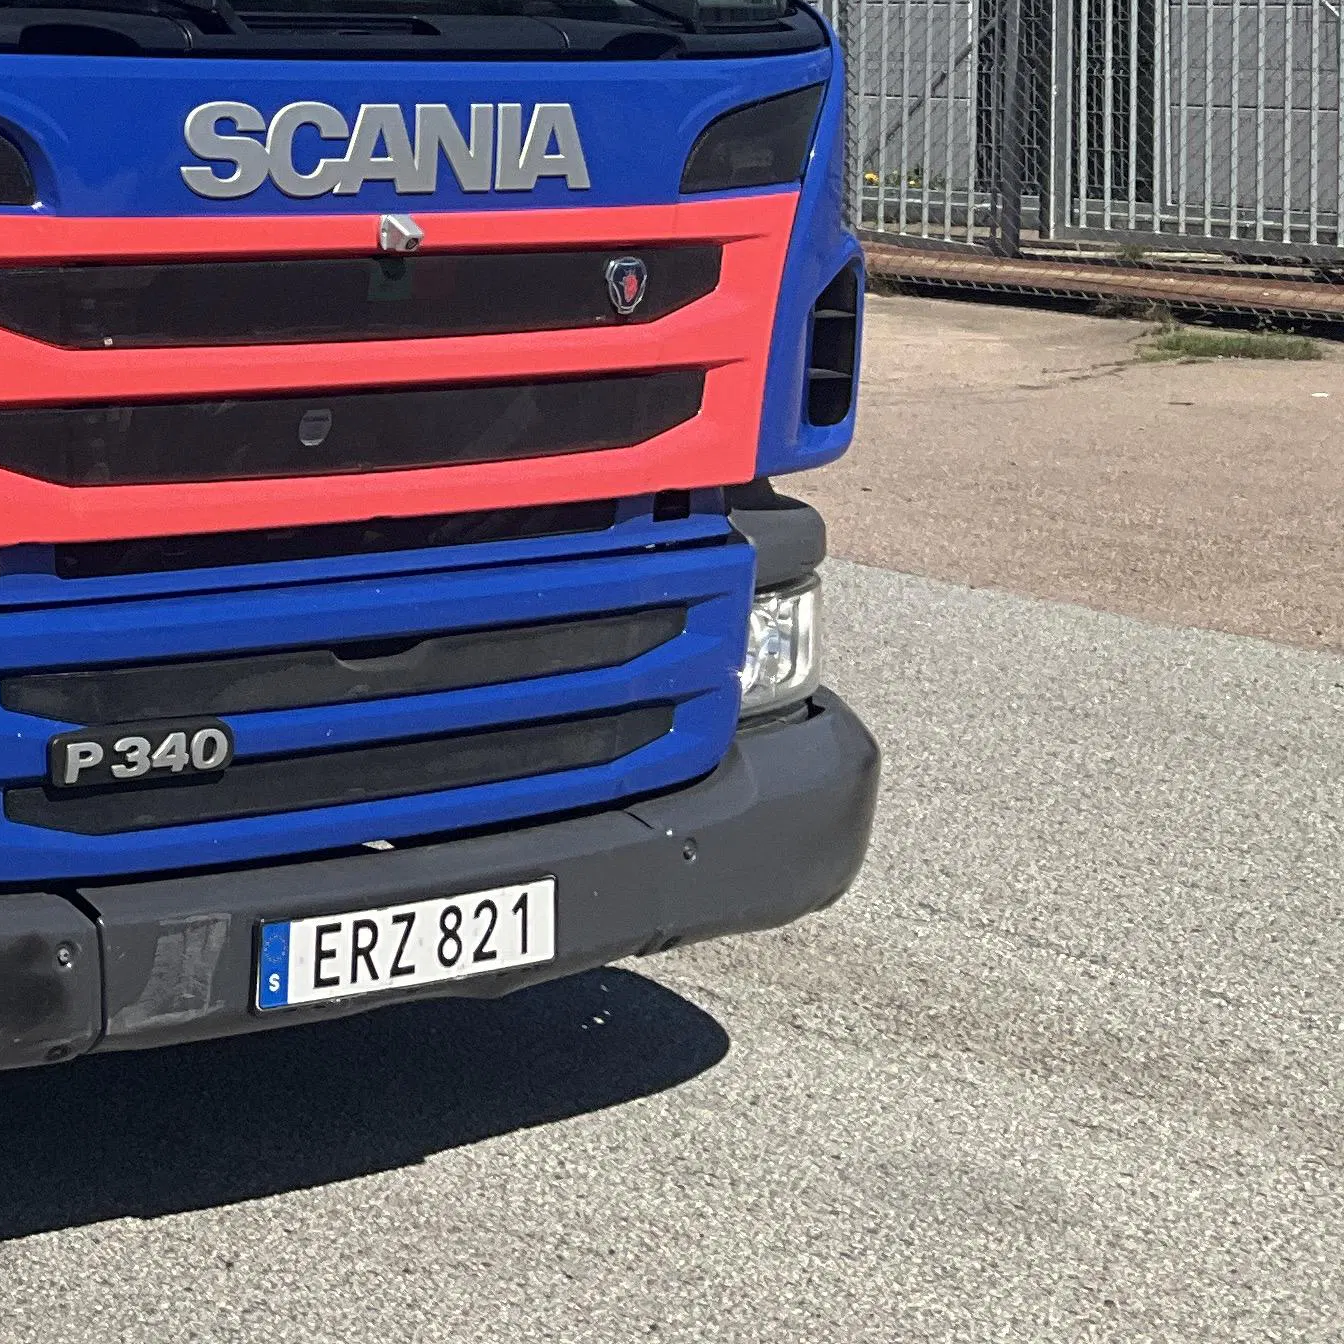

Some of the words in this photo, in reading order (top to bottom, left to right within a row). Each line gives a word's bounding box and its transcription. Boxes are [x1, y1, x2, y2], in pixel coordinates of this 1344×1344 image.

[180, 100, 592, 199] SCANIA
[65, 741, 104, 784] P
[111, 728, 229, 779] 340
[314, 911, 416, 989] ERZ
[437, 892, 529, 968] 821
[267, 973, 281, 993] S
